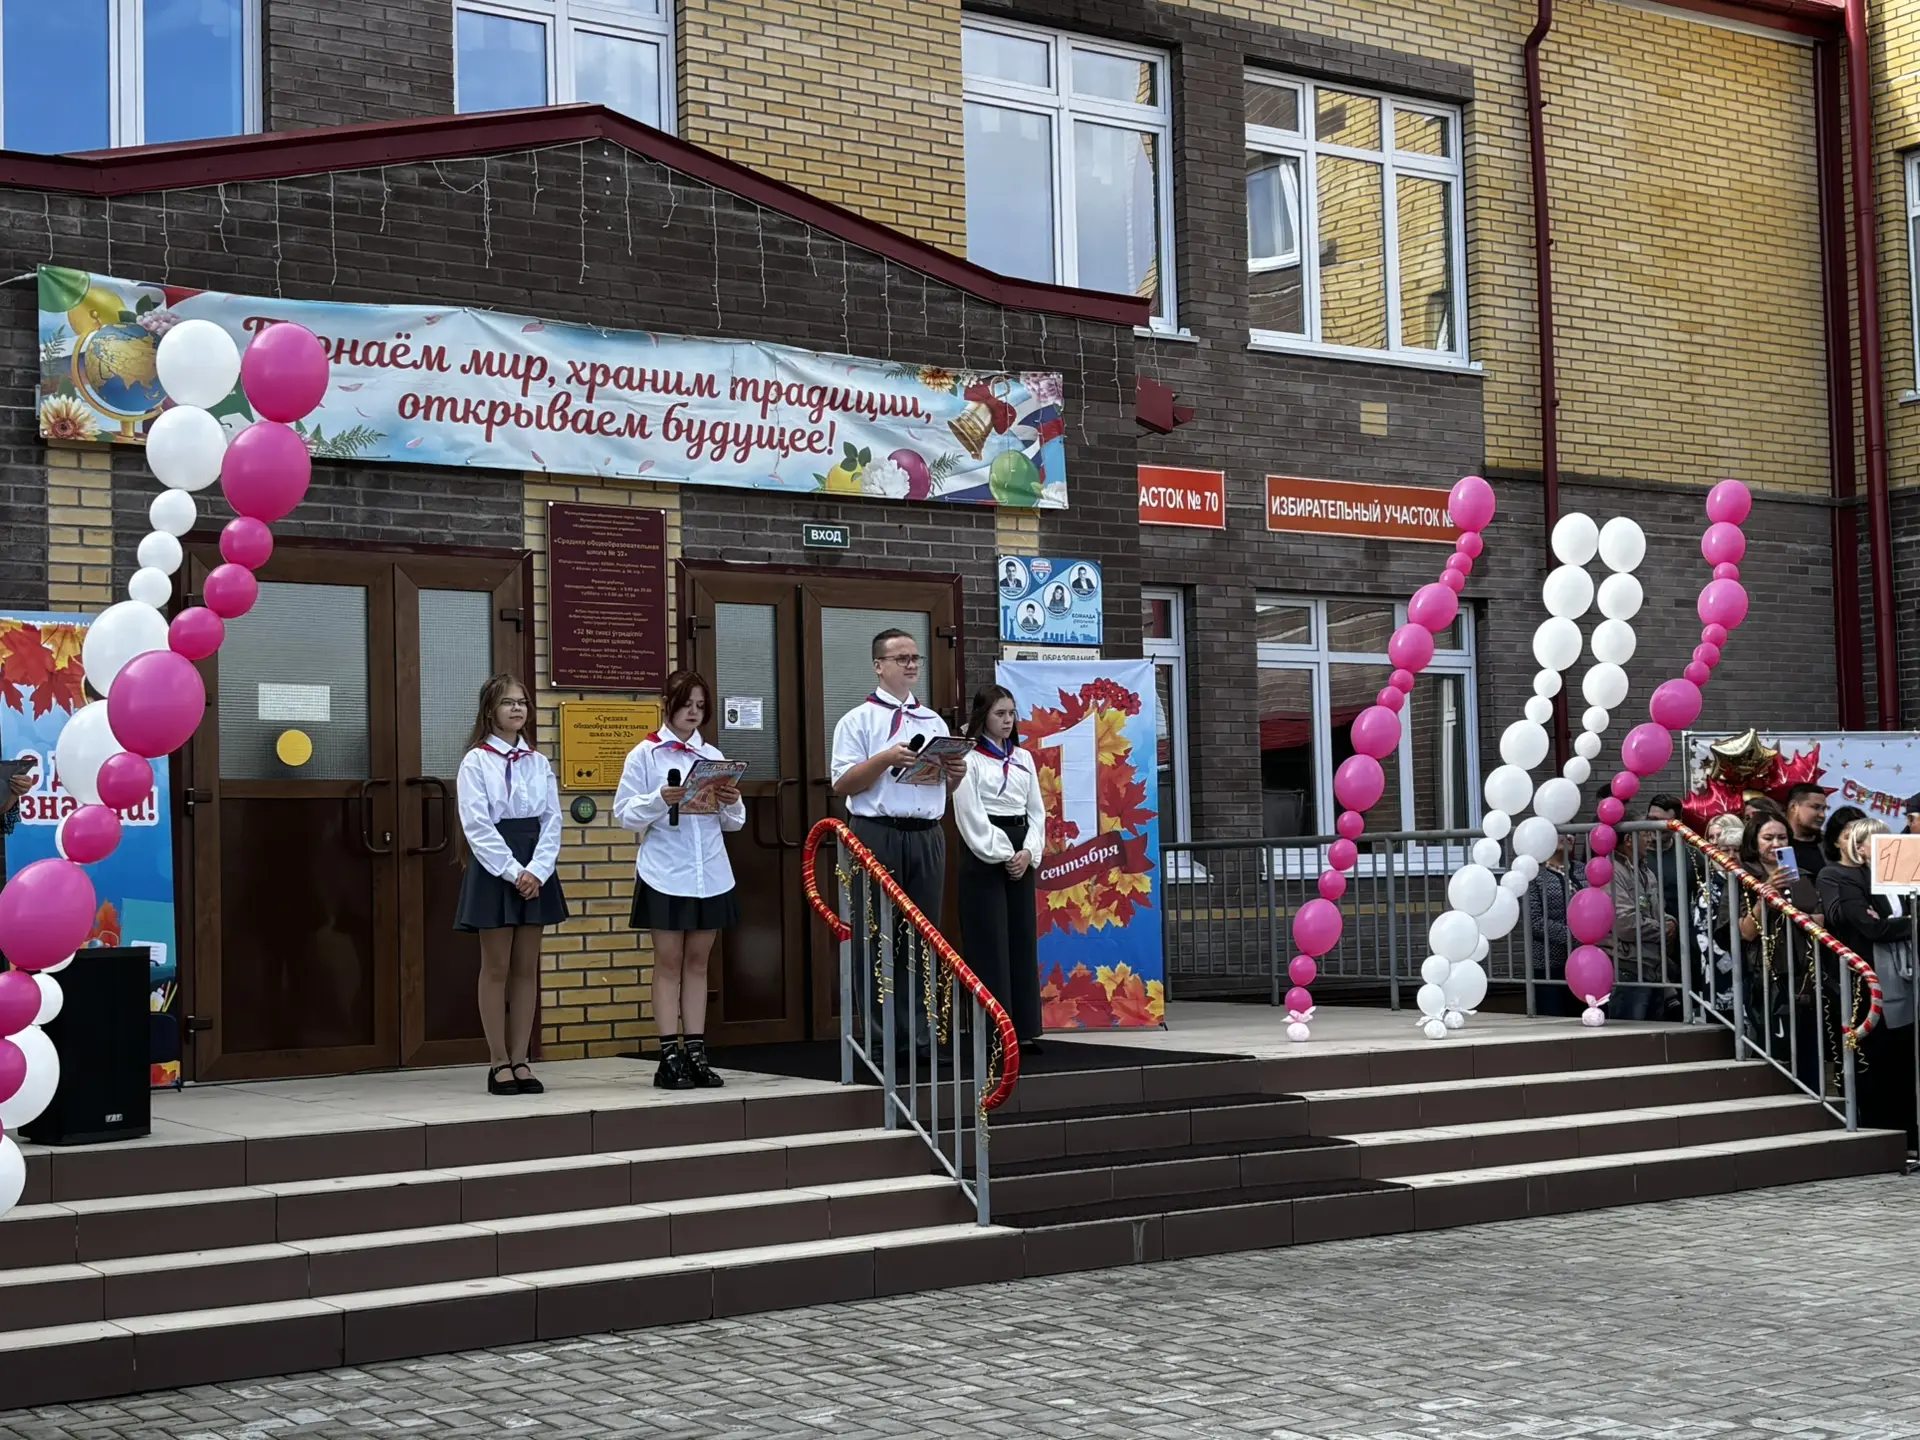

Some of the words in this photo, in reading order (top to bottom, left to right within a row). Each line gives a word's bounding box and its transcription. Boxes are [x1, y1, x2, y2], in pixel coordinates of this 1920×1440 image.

[459, 341, 557, 398] мир,
[566, 362, 720, 403] храним
[731, 374, 932, 424] традиции,
[398, 391, 652, 443] открываем
[663, 402, 837, 462] будущее!
[1187, 490, 1202, 510] №
[1204, 491, 1219, 512] 70
[1271, 495, 1381, 523] ИЗБИРАТЕЛЬНЫЙ
[1383, 506, 1441, 527] УЧАСТОК
[811, 529, 842, 543] ВХОД
[1040, 712, 1098, 848] 1
[1040, 843, 1120, 881] сентября
